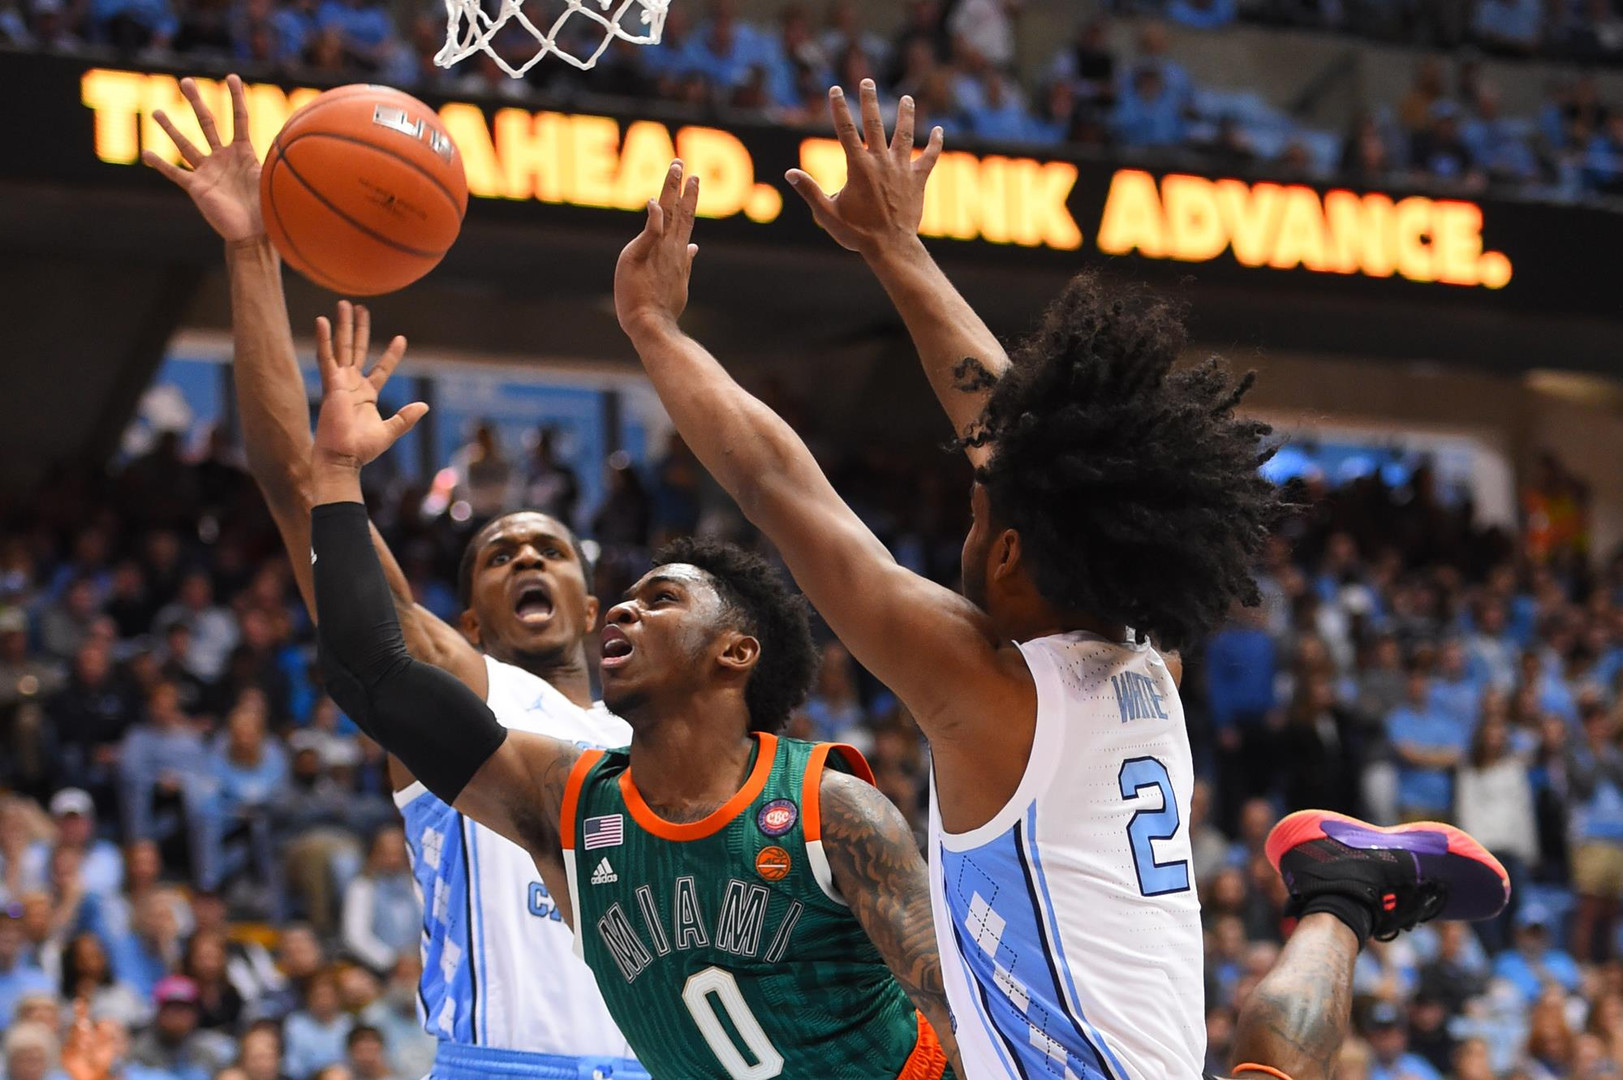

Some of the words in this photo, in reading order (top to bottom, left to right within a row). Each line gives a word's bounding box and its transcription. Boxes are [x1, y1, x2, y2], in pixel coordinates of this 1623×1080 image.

[437, 102, 782, 225] AHEAD.
[1098, 169, 1513, 289] ADVANCE.
[591, 872, 618, 885] adidas
[1118, 755, 1191, 897] 2
[597, 875, 804, 984] MIAMI
[681, 965, 785, 1080] 0
